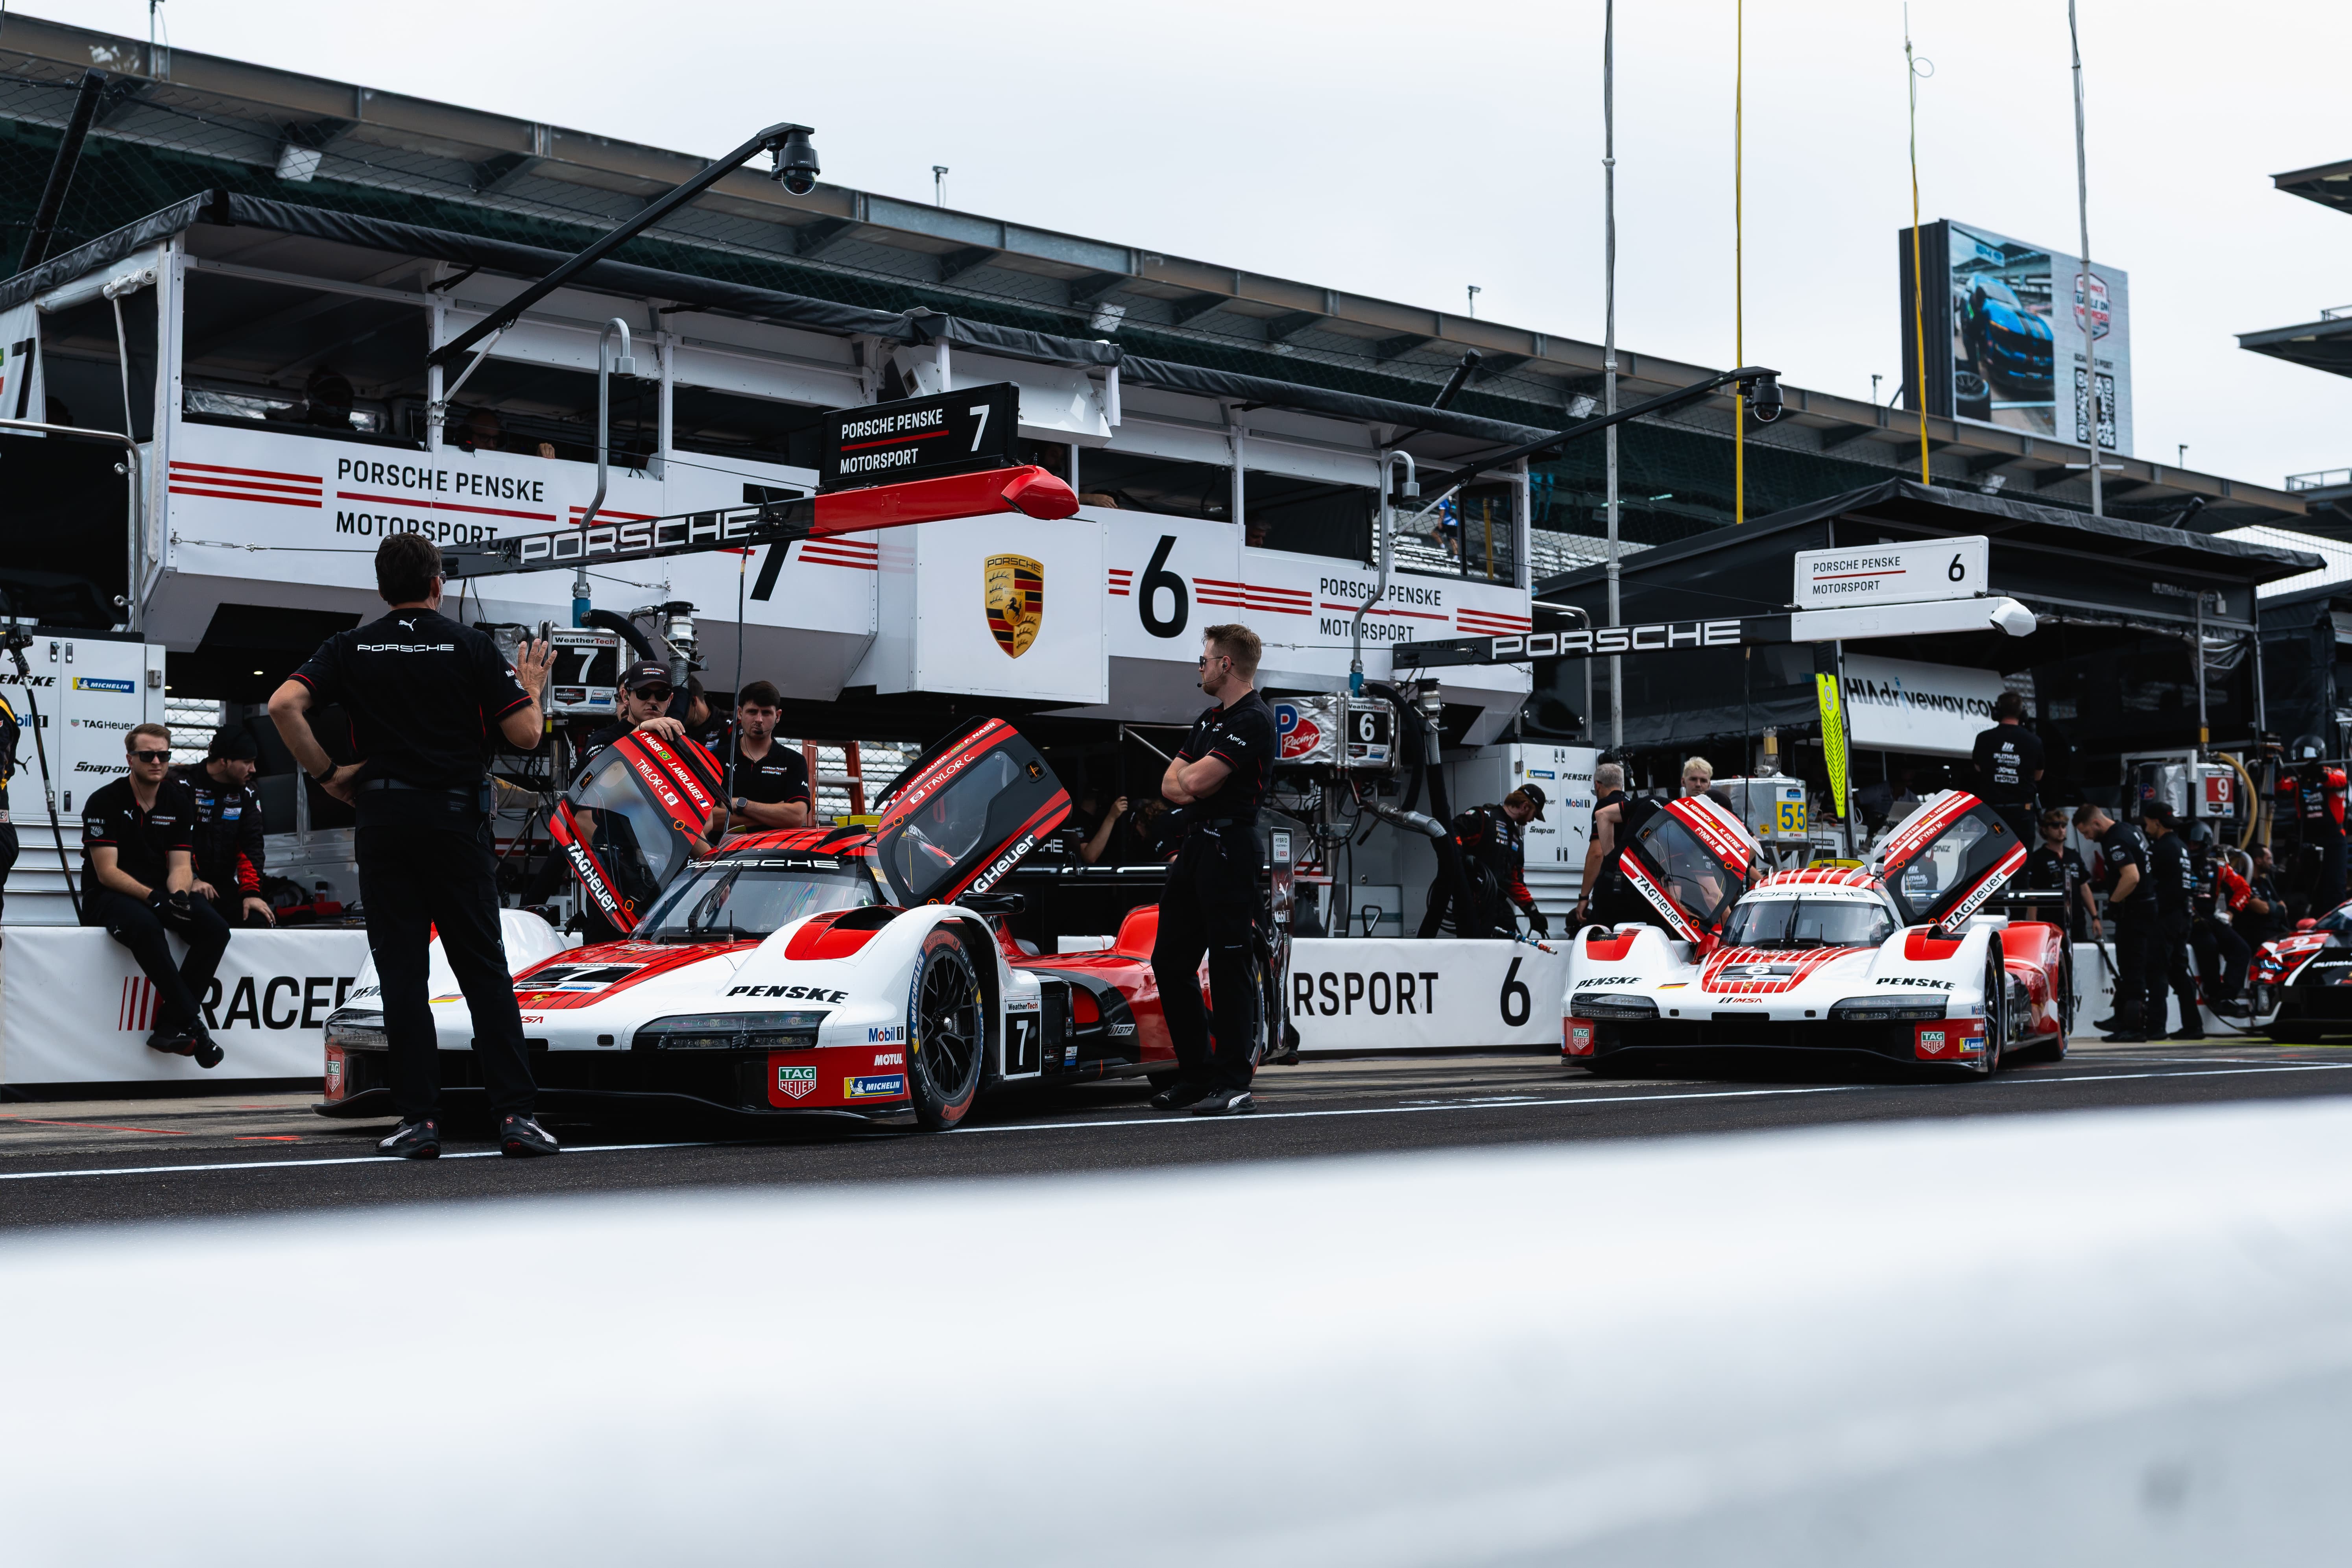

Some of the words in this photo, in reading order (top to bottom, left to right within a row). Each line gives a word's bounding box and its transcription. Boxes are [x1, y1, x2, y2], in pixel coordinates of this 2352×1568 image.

[12, 338, 35, 419] 7
[841, 416, 894, 440] PORSCHE
[897, 408, 943, 431] PENSKE
[969, 404, 990, 452] 7
[840, 448, 918, 474] MOTORSPORT
[338, 458, 447, 492] PORSCHE
[456, 472, 544, 502] PENSKE
[520, 508, 760, 564] PORSCHE
[987, 557, 1041, 574] PORSCHE
[1813, 560, 1859, 573] PORSCHE
[1862, 556, 1901, 569] PENSKE
[1948, 554, 1965, 582] 6
[1139, 535, 1189, 638] 6
[1388, 585, 1442, 606] PENSKE
[1812, 580, 1880, 595] MOTORSPORT
[358, 644, 454, 652] PORSCHE
[1492, 620, 1741, 660] PORSCHE
[574, 648, 598, 683] 7
[0, 674, 56, 687] ENSKE
[90, 682, 130, 690] MICHELIN
[1824, 685, 1834, 711] 9
[15, 713, 32, 727] bil
[1359, 713, 1375, 741] 6
[971, 722, 996, 739] NASR
[1227, 733, 1246, 746] Ansys
[1283, 731, 1321, 753] Racing
[74, 762, 131, 775] Snap-on
[636, 759, 663, 789] TAYLOR
[658, 785, 668, 796] C.
[645, 737, 663, 752] NASR
[672, 767, 703, 800] ANDLAUER
[906, 754, 948, 790] ANDLAUER
[923, 760, 964, 790] TAYLOR
[964, 754, 975, 763] C.
[1562, 773, 1592, 782] PENSKE
[2217, 778, 2229, 801] 9
[1566, 798, 1584, 808] Mobil
[1935, 794, 1962, 814] HEINRICH
[1781, 804, 1806, 830] 55
[1529, 826, 1555, 835] Snap-on
[1690, 804, 1712, 823] HEINRICH
[1723, 834, 1741, 849] ESTRE
[1695, 827, 1712, 843] FYNN
[1918, 826, 1937, 842] FYNN
[683, 860, 840, 870] PORSCHE
[1637, 875, 1684, 927] TAGHeuer
[1946, 872, 2003, 927] TAGHeuer
[559, 967, 609, 981] 7
[1745, 965, 1771, 975] 6
[911, 953, 924, 1025] MICHELIN
[1500, 957, 1531, 1027] 6
[1575, 977, 1643, 990] PENSKE
[1876, 978, 1955, 991] PENSKE
[346, 985, 380, 1005] PEN
[726, 986, 849, 1004] PENSKE
[1293, 971, 1439, 1016] RSPORT
[868, 1027, 895, 1042] Mobil
[1017, 1020, 1028, 1066] 7
[1574, 1038, 1588, 1047] HEUER
[1923, 1041, 1943, 1053] HEUER
[328, 1063, 339, 1074] TAG
[874, 1053, 903, 1066] MOTUL
[327, 1075, 339, 1089] HEUER
[782, 1068, 813, 1078] TAG
[781, 1079, 814, 1097] HEUER
[866, 1080, 900, 1091] MICHELIN
